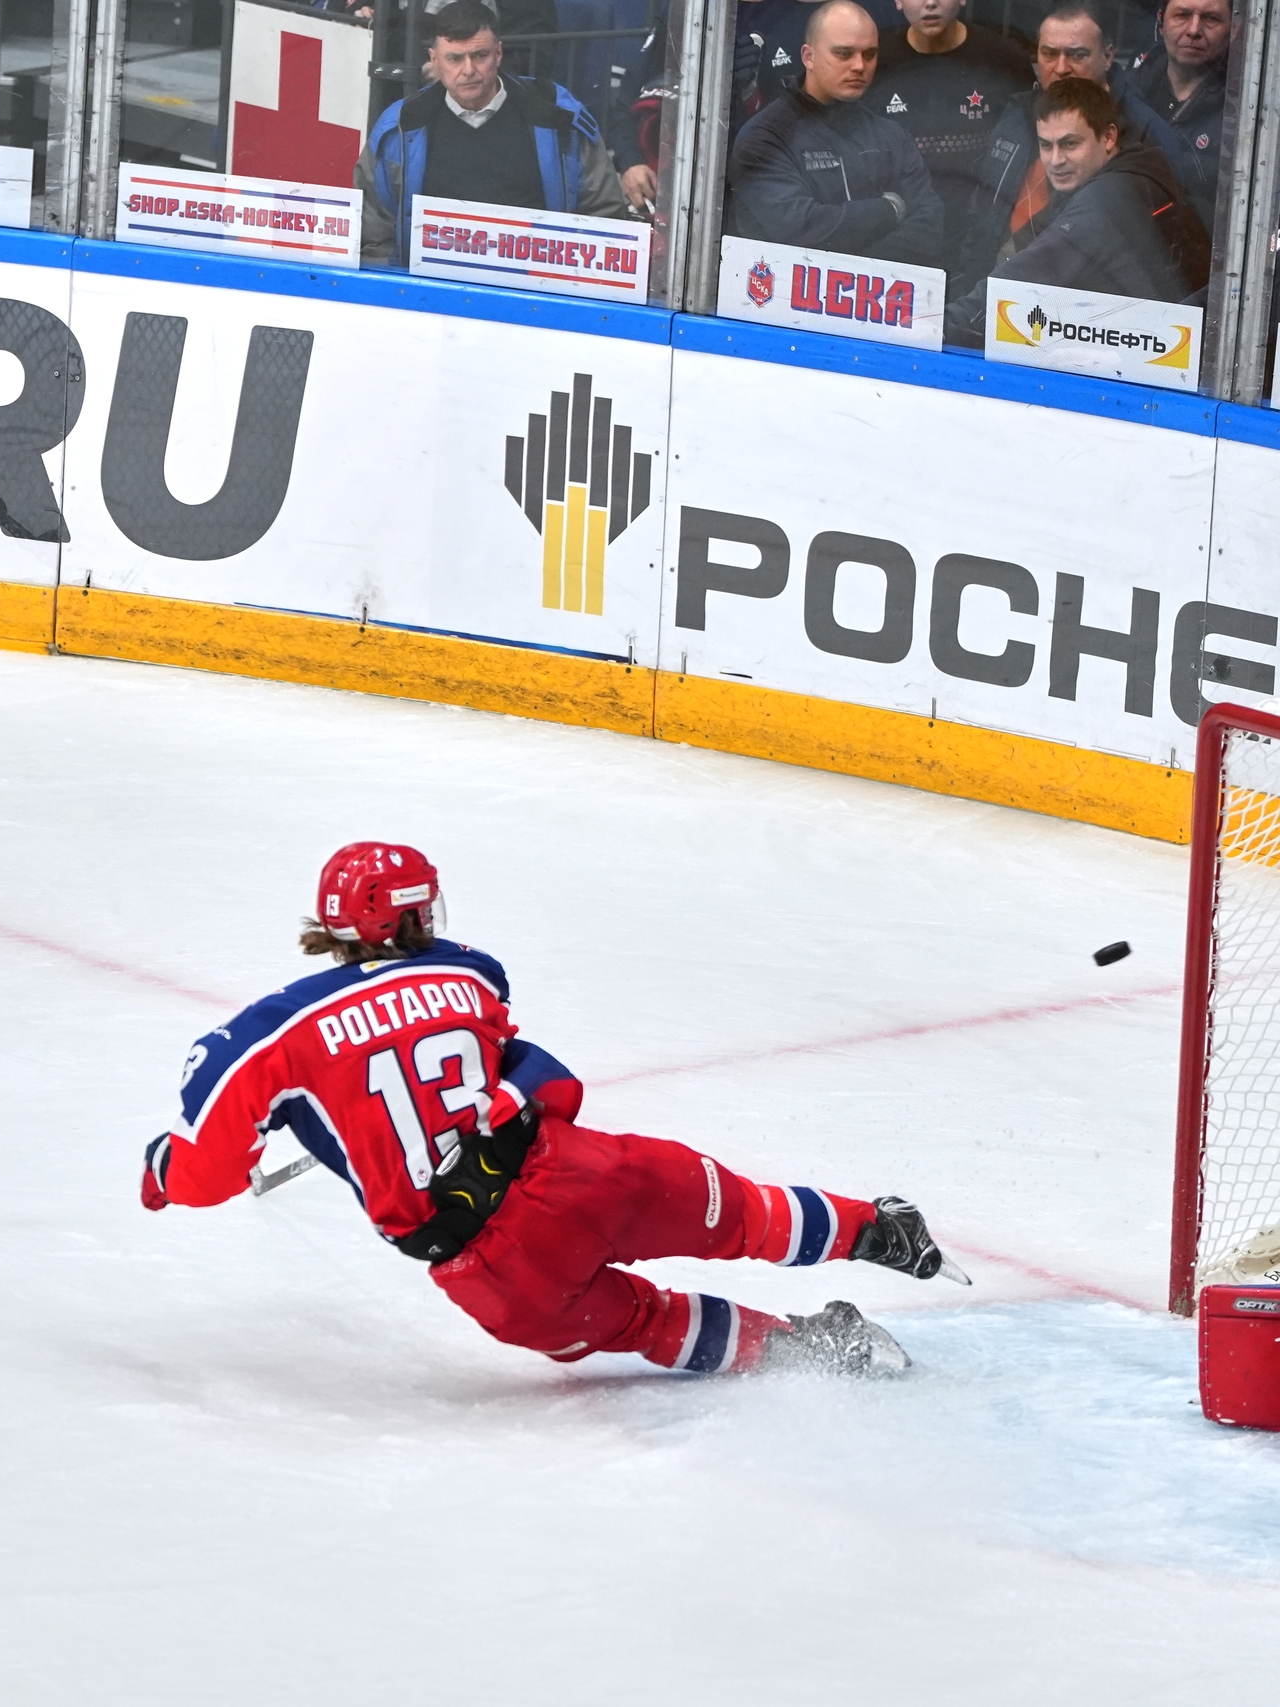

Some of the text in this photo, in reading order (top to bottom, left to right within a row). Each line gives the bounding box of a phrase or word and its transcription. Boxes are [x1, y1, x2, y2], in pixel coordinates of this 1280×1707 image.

[771, 55, 793, 67] PEAK
[886, 103, 908, 114] PEAK
[128, 194, 350, 237] SHOP.CSKA-HOCKEY.RU
[422, 223, 638, 275] CSKA-HOCKEY.RU
[791, 263, 915, 329] ЦСКА
[1049, 321, 1167, 354] РОСНЕФТЬ
[326, 894, 340, 917] 13
[317, 981, 483, 1056] POLTAPOV
[366, 1028, 494, 1191] 13
